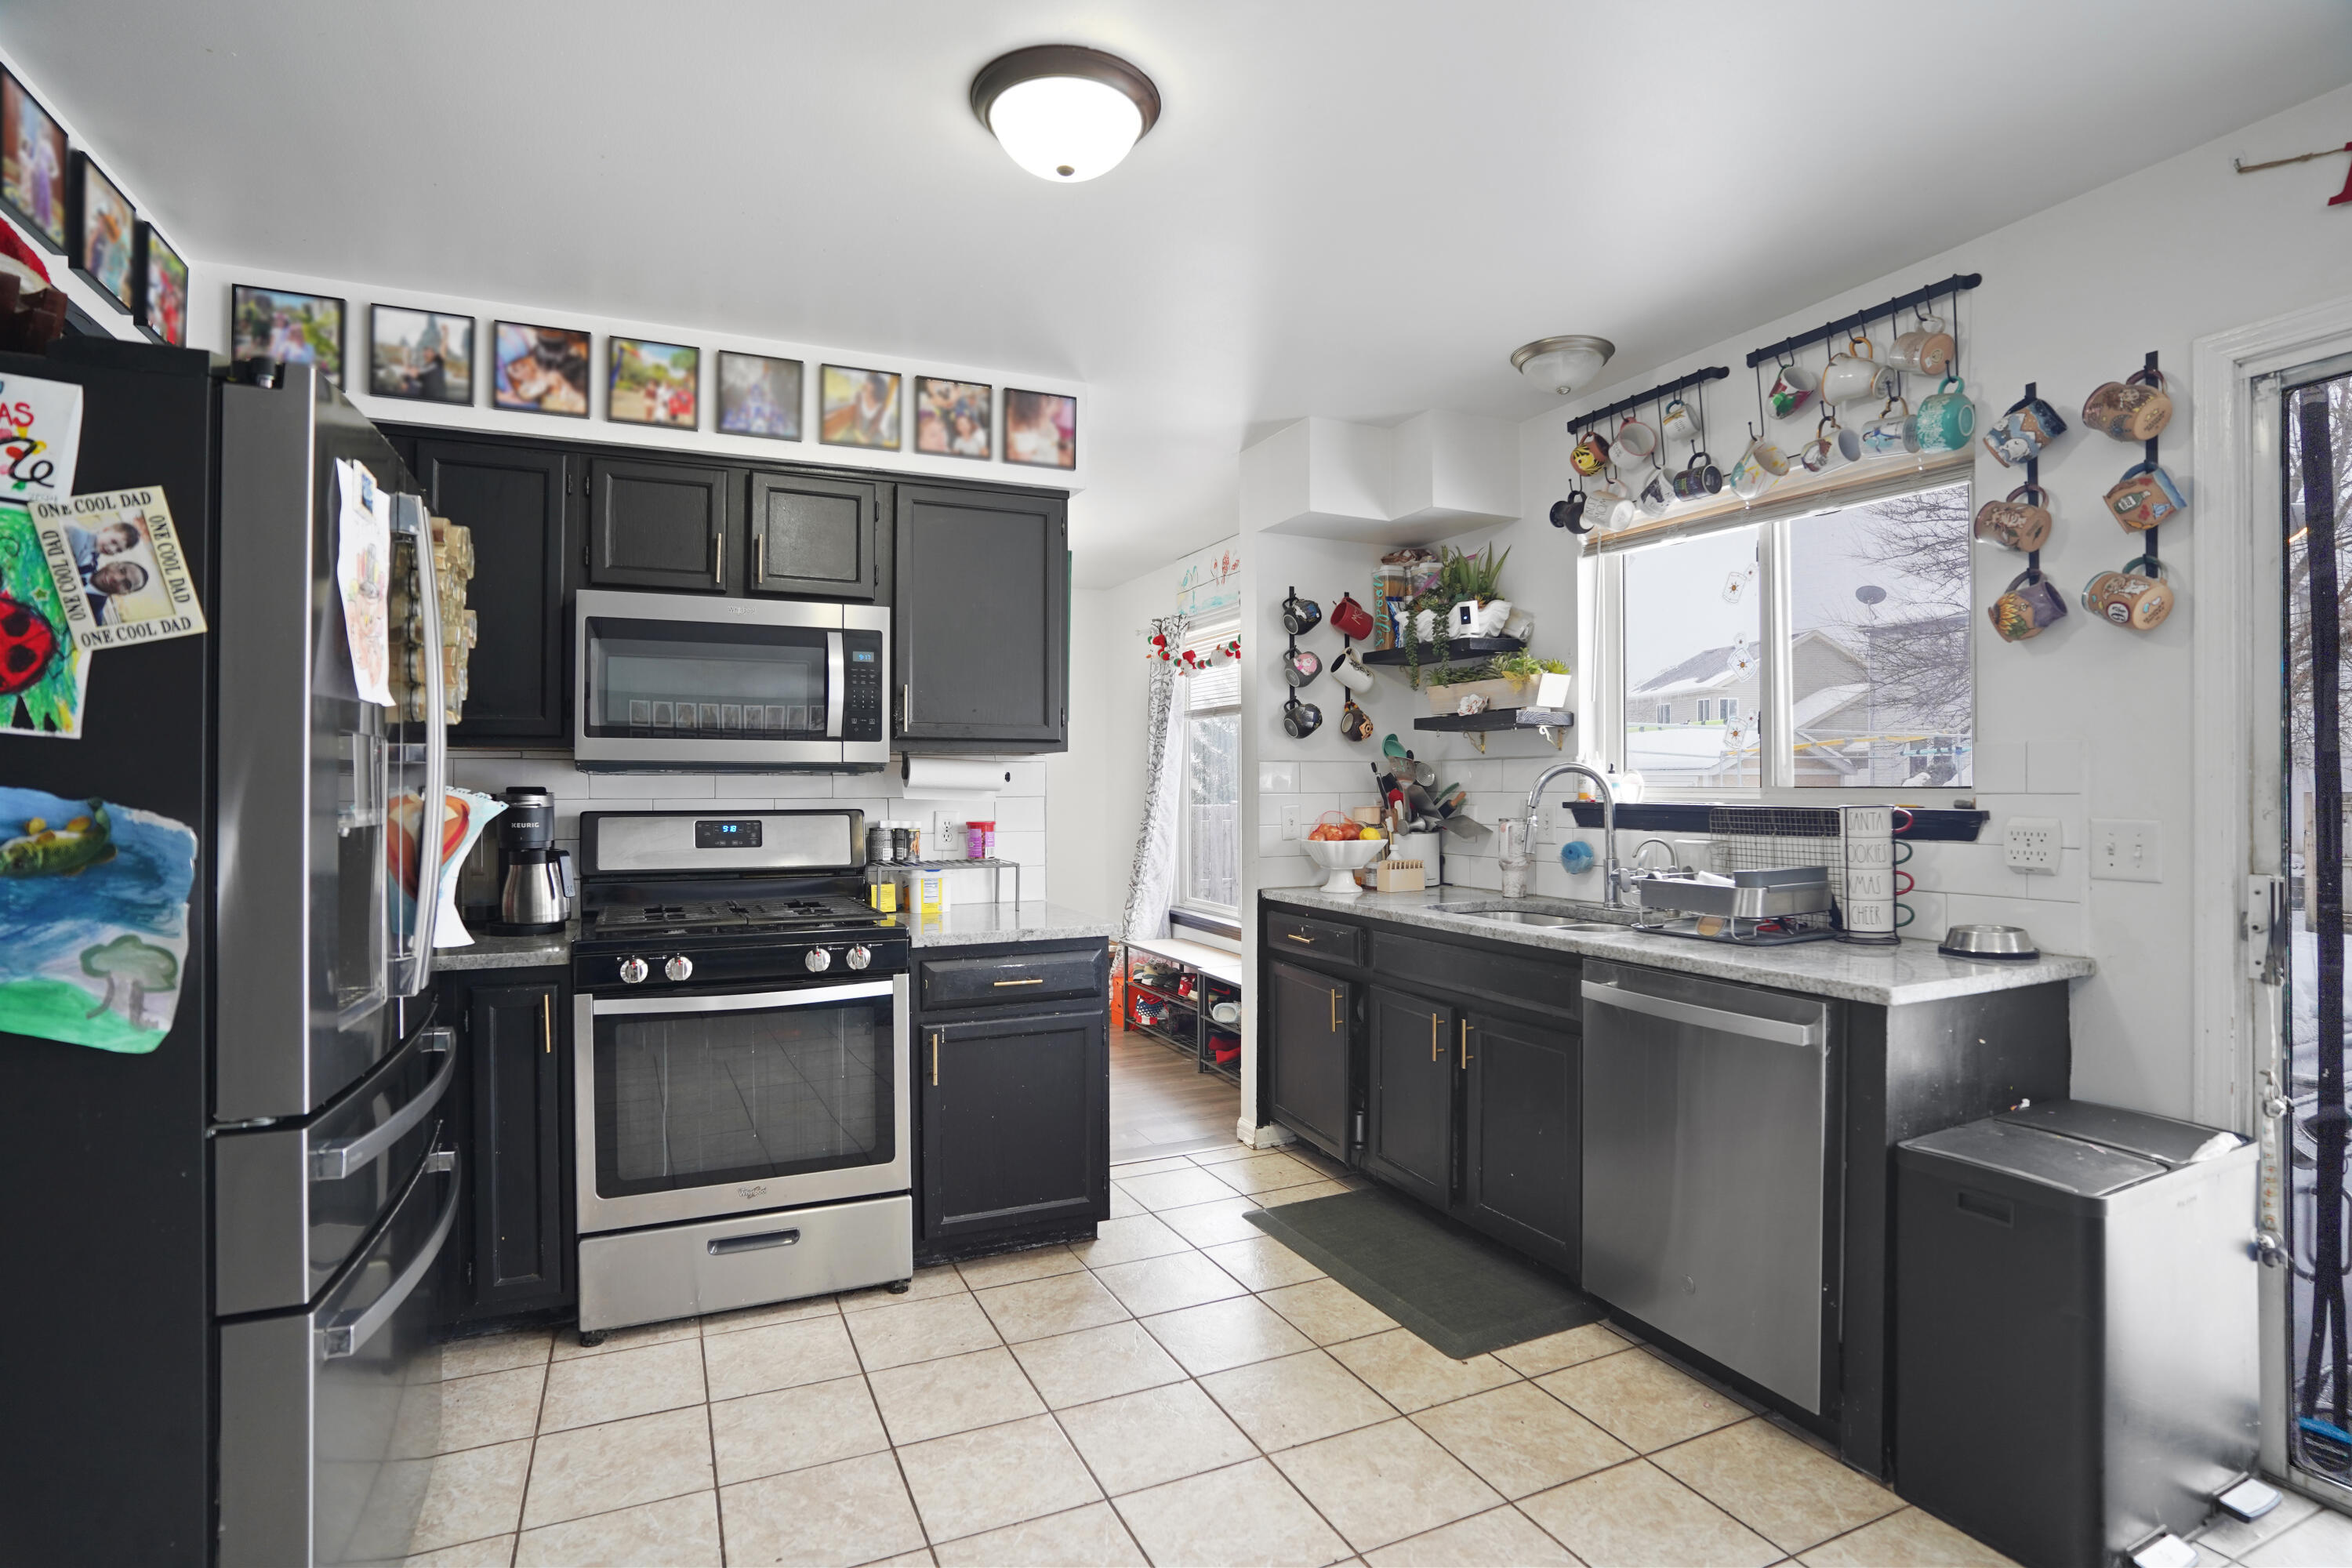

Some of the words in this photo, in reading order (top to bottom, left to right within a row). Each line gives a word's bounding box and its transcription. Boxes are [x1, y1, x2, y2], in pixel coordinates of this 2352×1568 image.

[74, 496, 117, 514] COOL
[119, 491, 152, 507] DAD
[148, 514, 171, 540] ONE
[42, 530, 64, 557] DAD
[157, 542, 181, 575] COOL
[52, 561, 77, 593] COOL
[169, 577, 191, 604] DAD
[63, 596, 86, 622] ONE
[81, 630, 114, 648] ONE
[115, 622, 157, 641] COOL
[160, 616, 192, 633] DAD
[1848, 811, 1884, 830] SANTA
[1847, 844, 1888, 863] OOKIES
[1850, 906, 1882, 925] CHEER
[738, 1185, 767, 1199] Whirlpool
